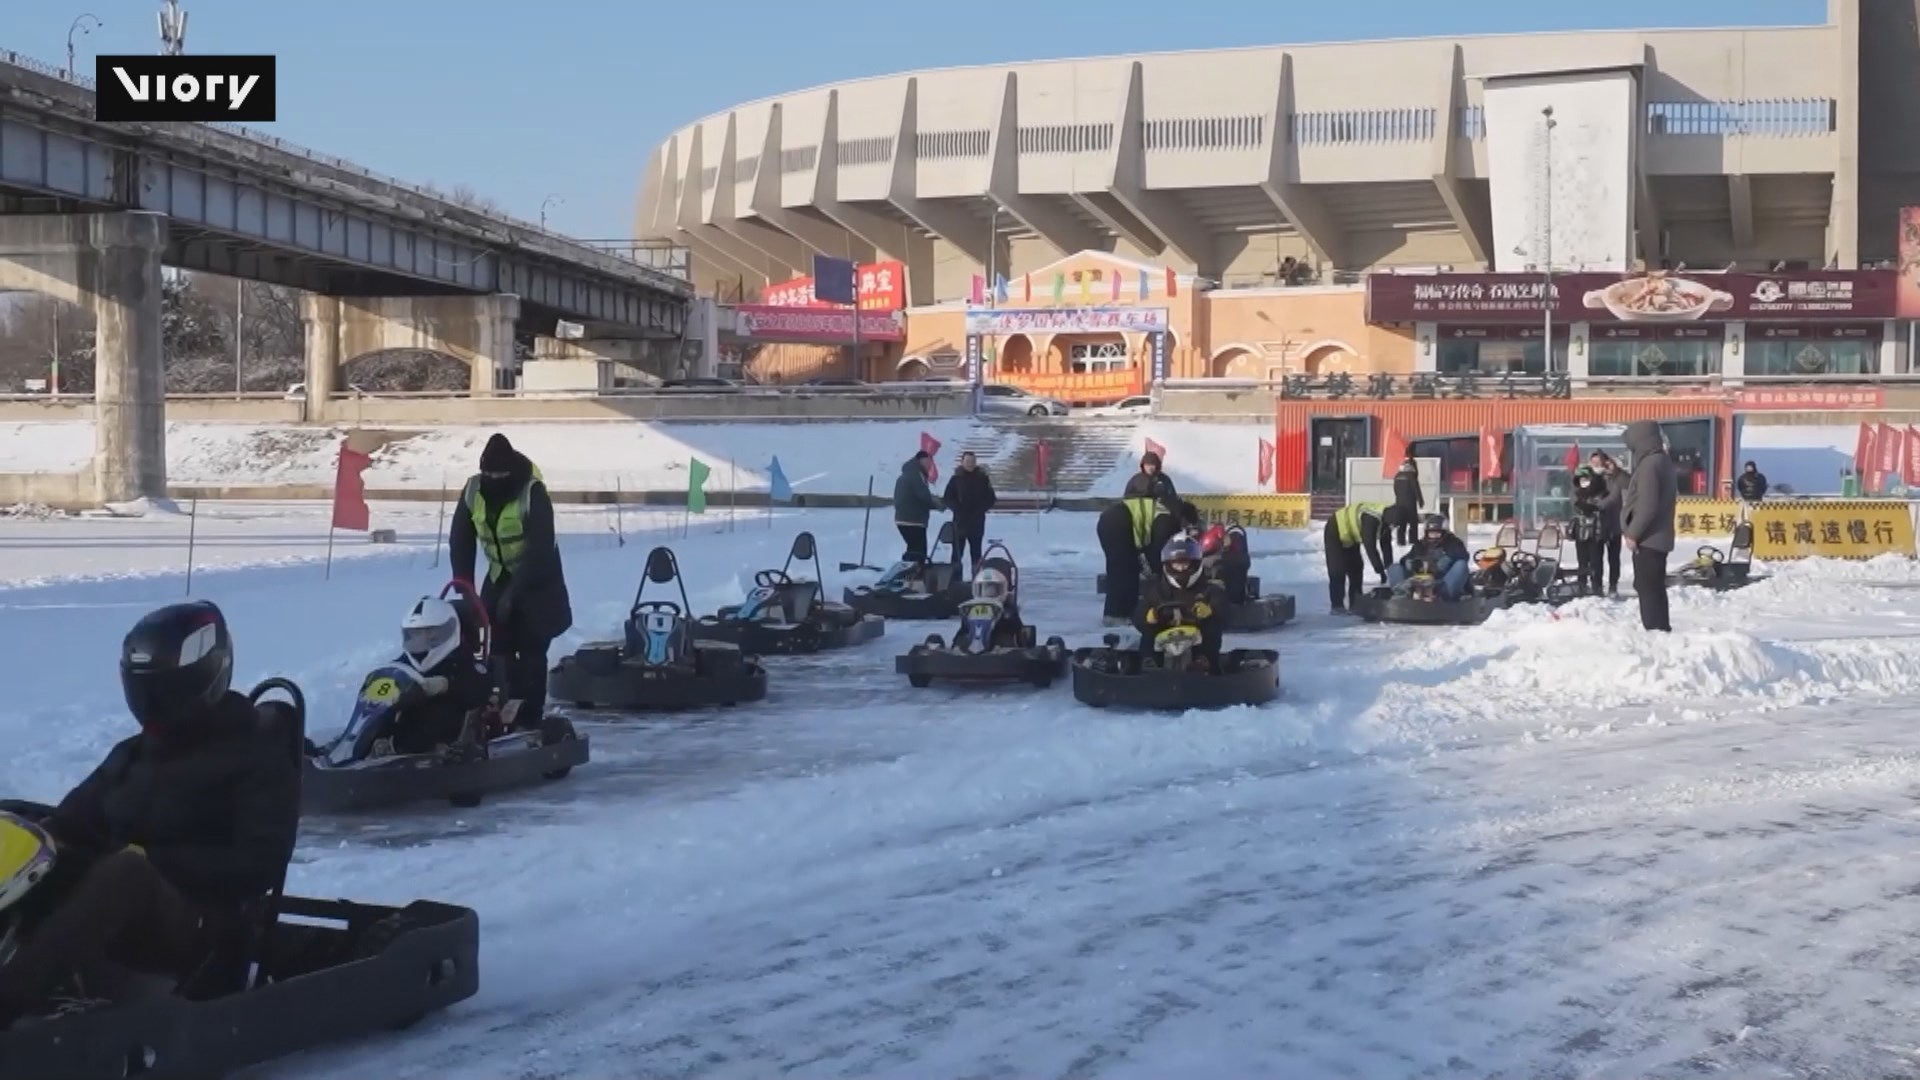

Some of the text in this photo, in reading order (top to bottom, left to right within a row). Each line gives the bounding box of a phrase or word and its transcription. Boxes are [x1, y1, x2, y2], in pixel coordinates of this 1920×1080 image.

[1765, 519, 1894, 545] 请减速慢行
[377, 683, 391, 696] 8
